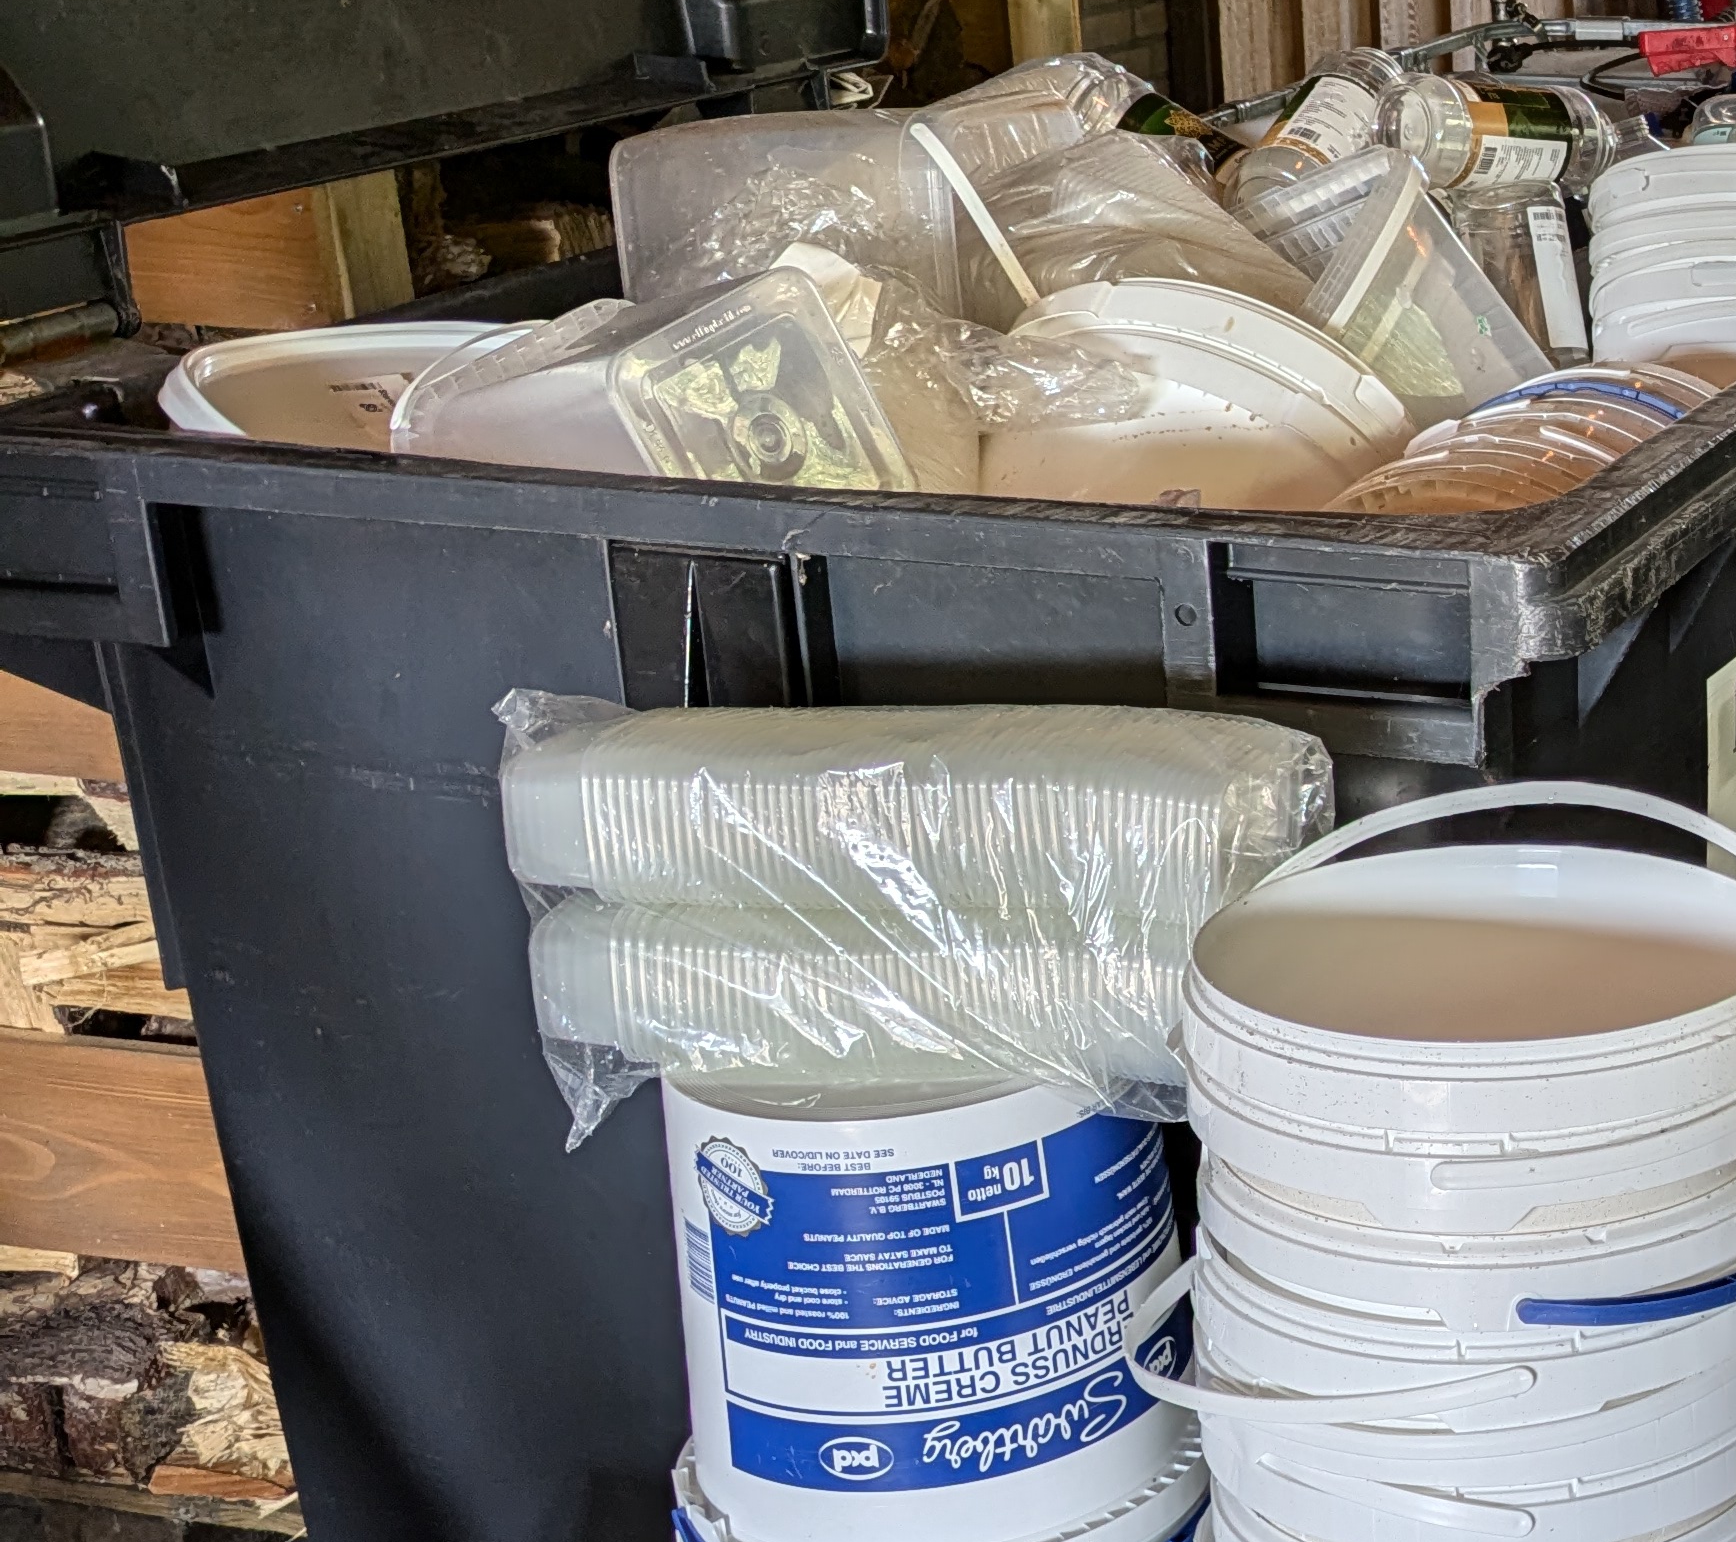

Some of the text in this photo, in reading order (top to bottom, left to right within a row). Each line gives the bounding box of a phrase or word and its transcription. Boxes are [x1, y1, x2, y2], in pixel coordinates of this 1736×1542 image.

[771, 1147, 894, 1159] SEE DATE ON LID/COVER
[720, 1157, 743, 1178] 100
[796, 1161, 870, 1171] BEST BEFORE:
[983, 1165, 1000, 1180] kg
[711, 1165, 749, 1197] PARTNER
[884, 1167, 942, 1183] NEDERLAND
[929, 1177, 943, 1188] NL
[967, 1157, 1034, 1202] 10 netto
[700, 1166, 760, 1214] YOUR TRUSTED
[829, 1185, 885, 1196] ROTTERDAM
[887, 1183, 900, 1192] PC
[900, 1187, 944, 1200] POSTBUS
[868, 1196, 946, 1213] SWARTBERG B.V.
[802, 1223, 949, 1242] MADE OF TOP QUALITY PEANUTS
[842, 1242, 952, 1262] TO MAKE SATAY SAUCE
[786, 1253, 953, 1271] FOR GENERATIONS THE BEST CHOICE
[790, 1283, 817, 1294] bucket
[871, 1287, 957, 1305] STORAGE ADVICE:
[773, 1291, 842, 1305] store cool and dry
[778, 1305, 793, 1315] and
[794, 1306, 825, 1317] roasted
[826, 1309, 849, 1319] 100%
[892, 1300, 959, 1316] INGREDIENTS:
[743, 1325, 979, 1351] for FOOD SERVICE and FOOD INDUSTRY
[885, 1288, 1130, 1382] PEANUT BUTTER
[881, 1314, 1133, 1408] RDNUSS CREME
[922, 1370, 1128, 1473] Swartberg
